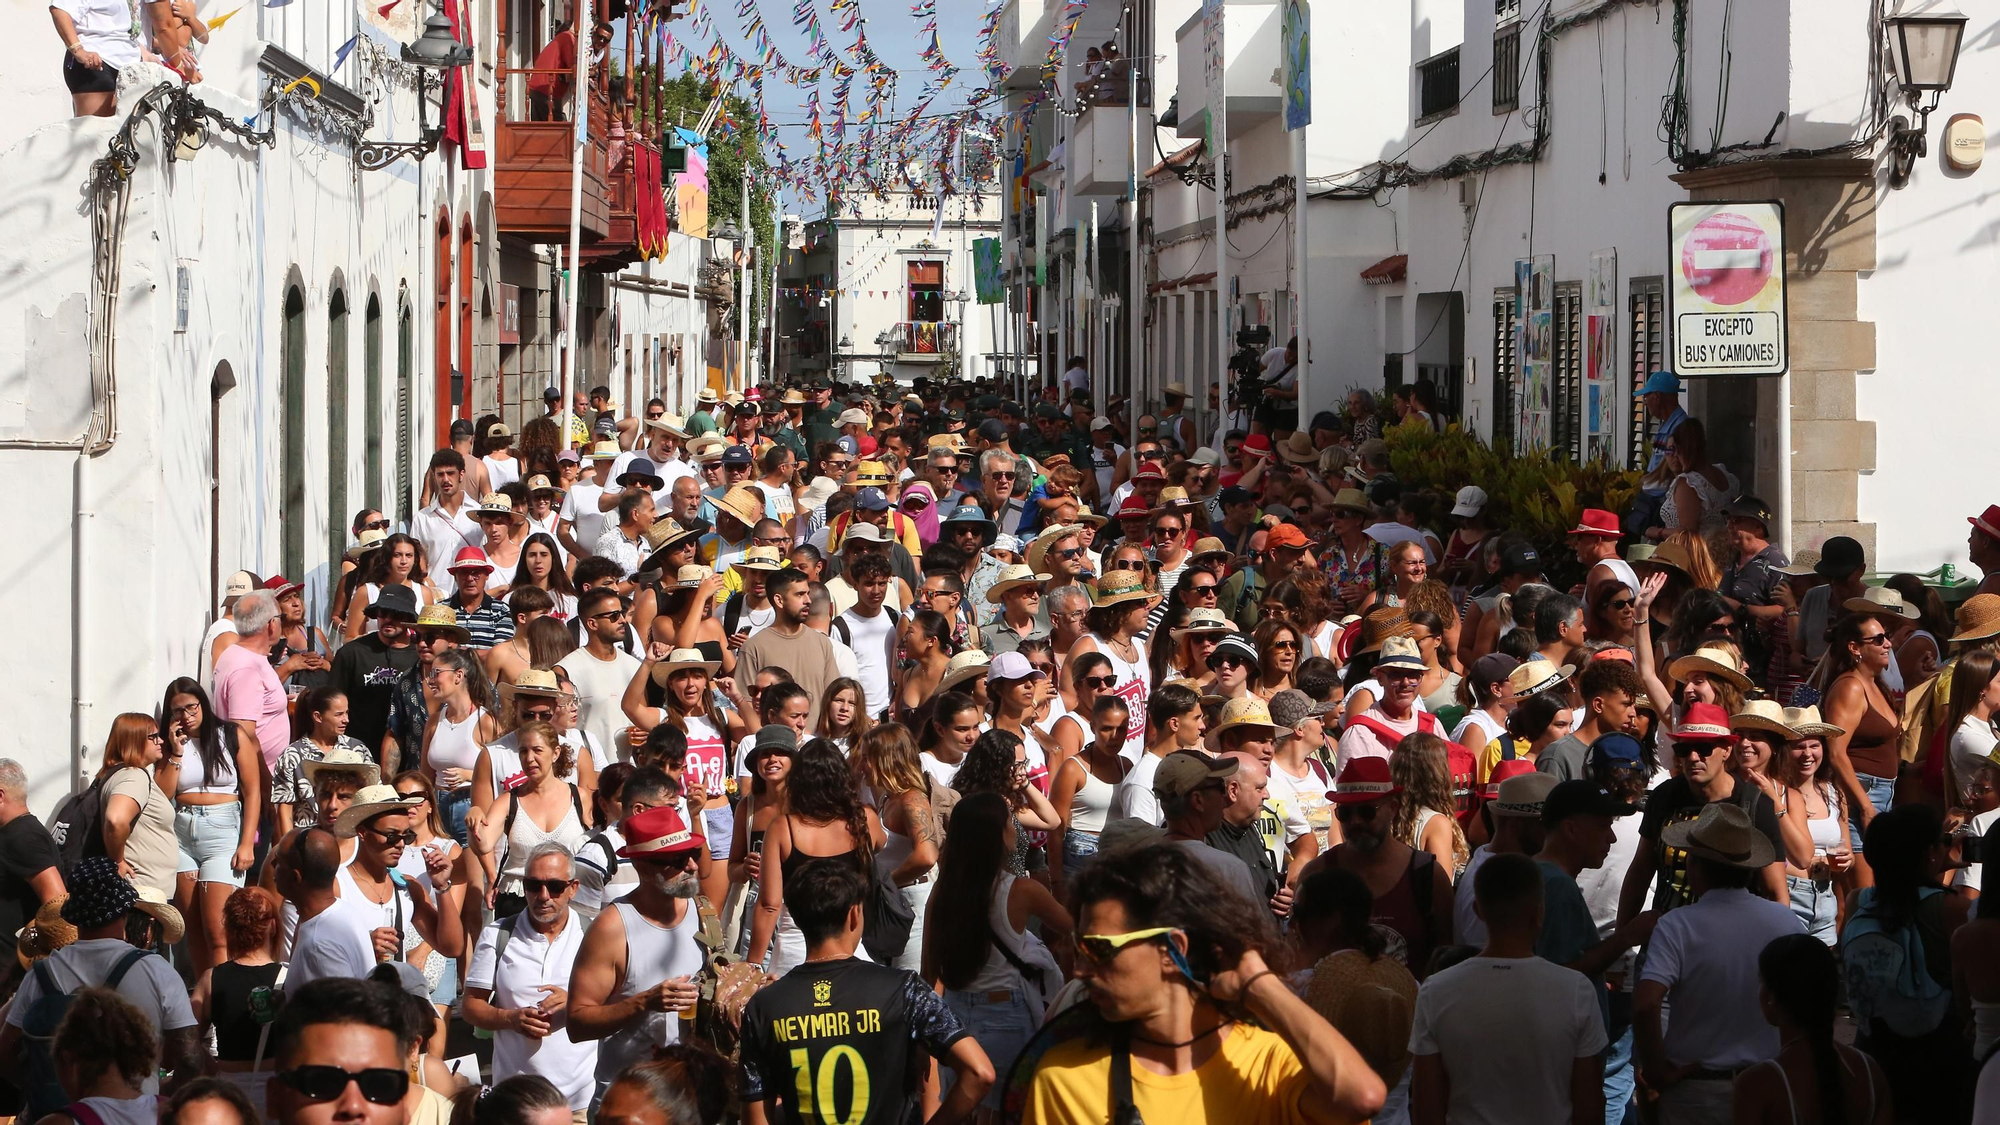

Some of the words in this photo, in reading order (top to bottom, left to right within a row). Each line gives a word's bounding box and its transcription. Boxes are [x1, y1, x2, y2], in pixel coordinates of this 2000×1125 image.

[1705, 318, 1753, 337] EXCEPTO
[1685, 345, 1707, 362] BUS
[1709, 345, 1717, 362] Y
[1719, 344, 1774, 362] CAMIONES
[660, 834, 682, 847] BANDA
[774, 1012, 851, 1043] NEYMAR
[856, 1008, 881, 1034] JR
[789, 1044, 870, 1125] 10
